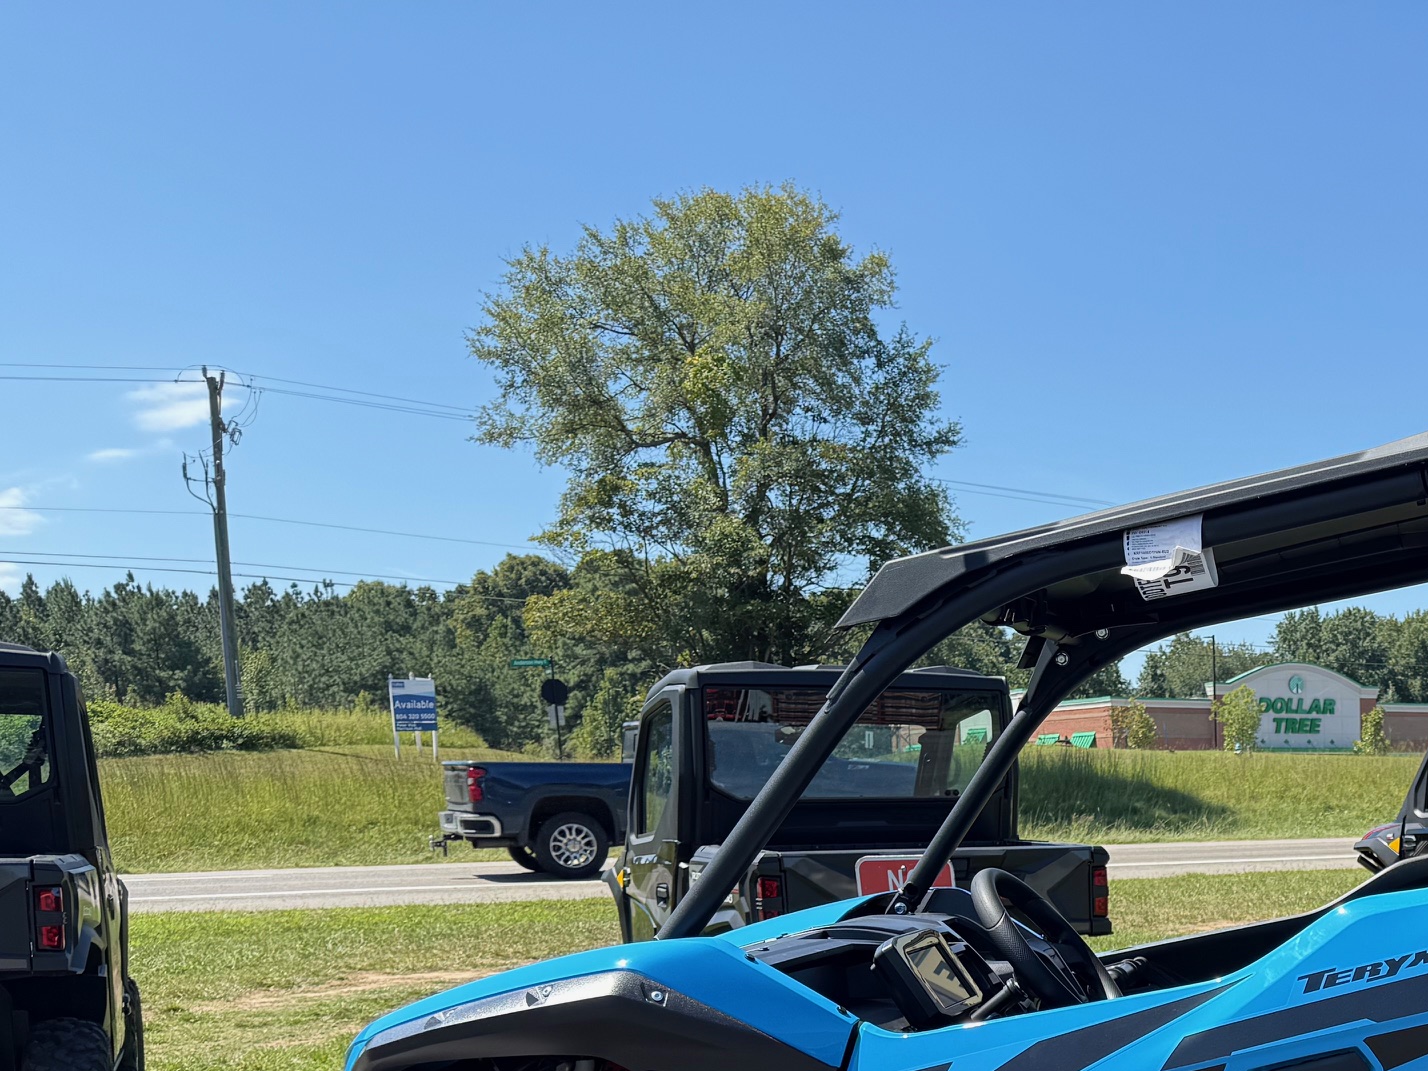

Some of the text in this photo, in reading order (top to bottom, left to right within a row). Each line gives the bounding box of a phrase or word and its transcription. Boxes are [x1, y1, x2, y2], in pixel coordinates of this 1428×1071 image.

[394, 699, 435, 709] Available
[1258, 697, 1336, 715] DOLLAR
[1273, 717, 1322, 734] TREE
